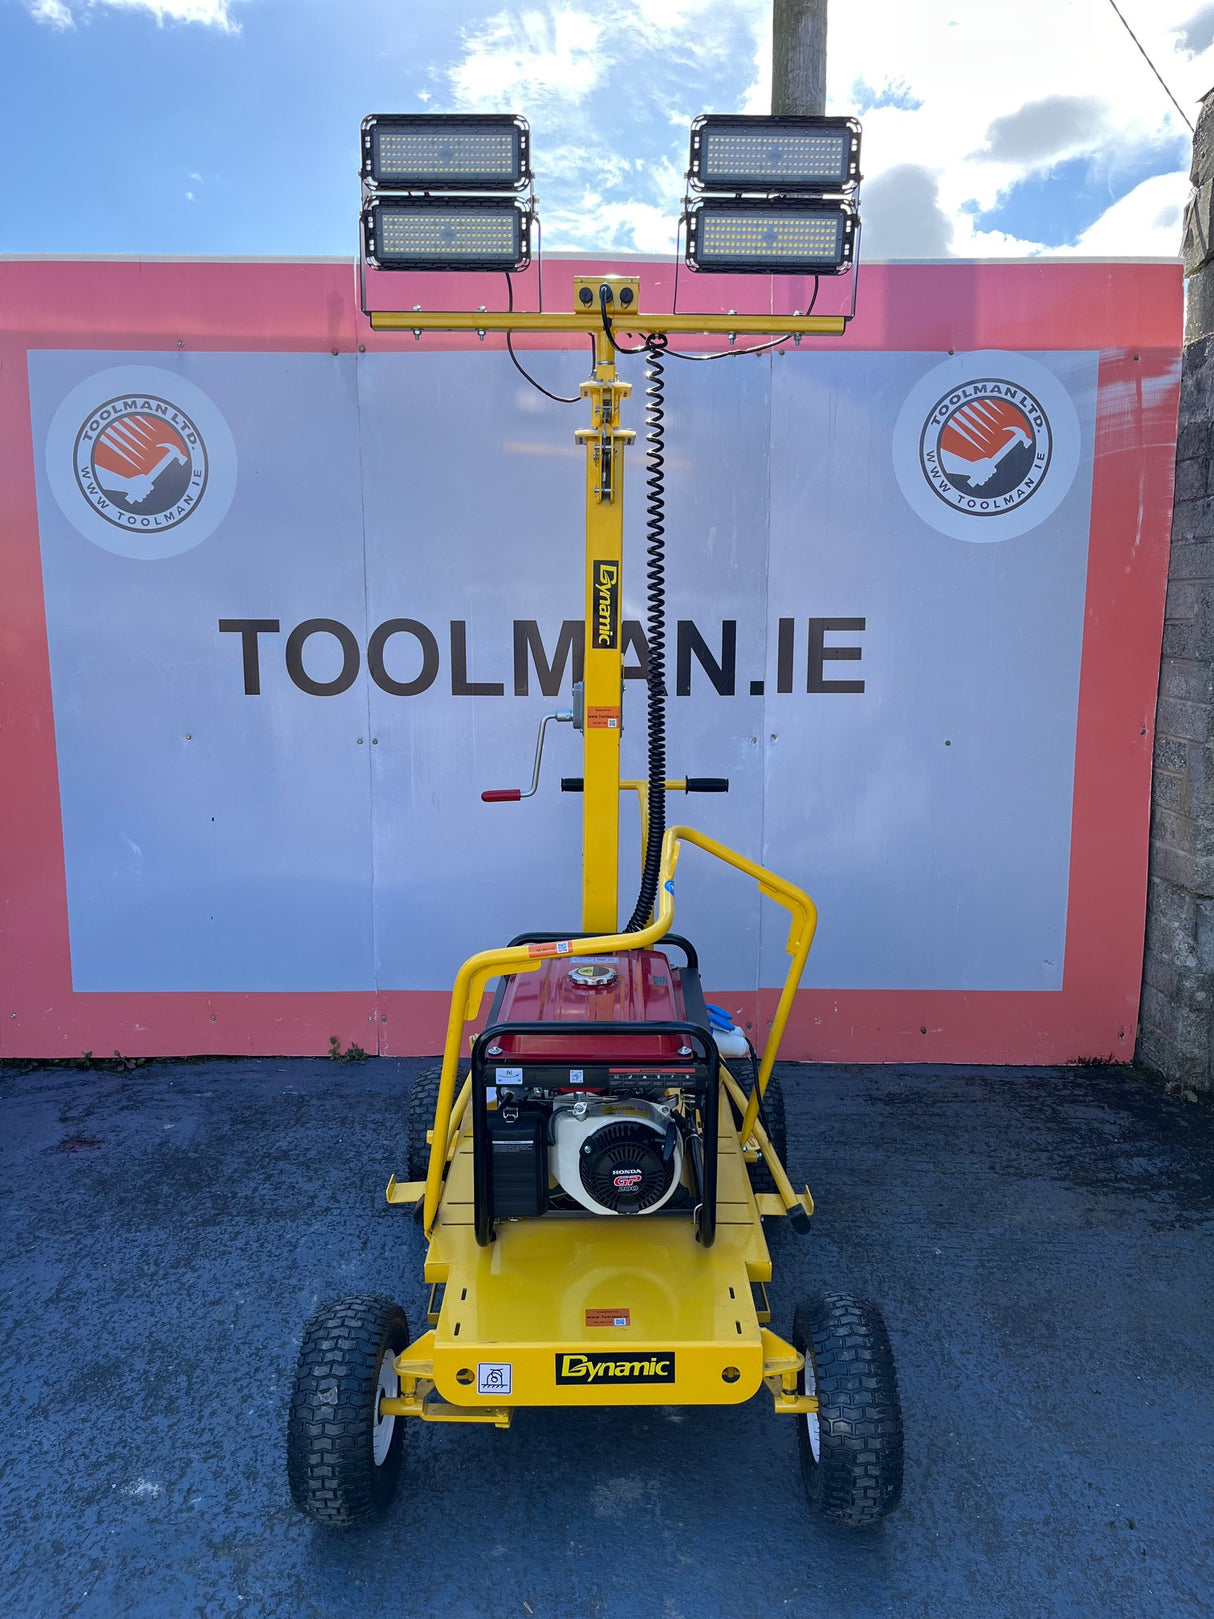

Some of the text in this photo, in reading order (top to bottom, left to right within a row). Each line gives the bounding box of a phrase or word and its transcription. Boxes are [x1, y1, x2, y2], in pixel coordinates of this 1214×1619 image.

[82, 400, 198, 450] TOOLMAN LTD.
[931, 385, 1044, 434] TOOLMAN LTD.
[117, 495, 194, 526] TOOLMAN
[957, 478, 1035, 510] TOOLMAN
[595, 563, 617, 646] Dynamic
[218, 617, 867, 697] TOOLMAN.IE
[613, 1174, 643, 1187] GP
[561, 1354, 670, 1383] Dynamic
